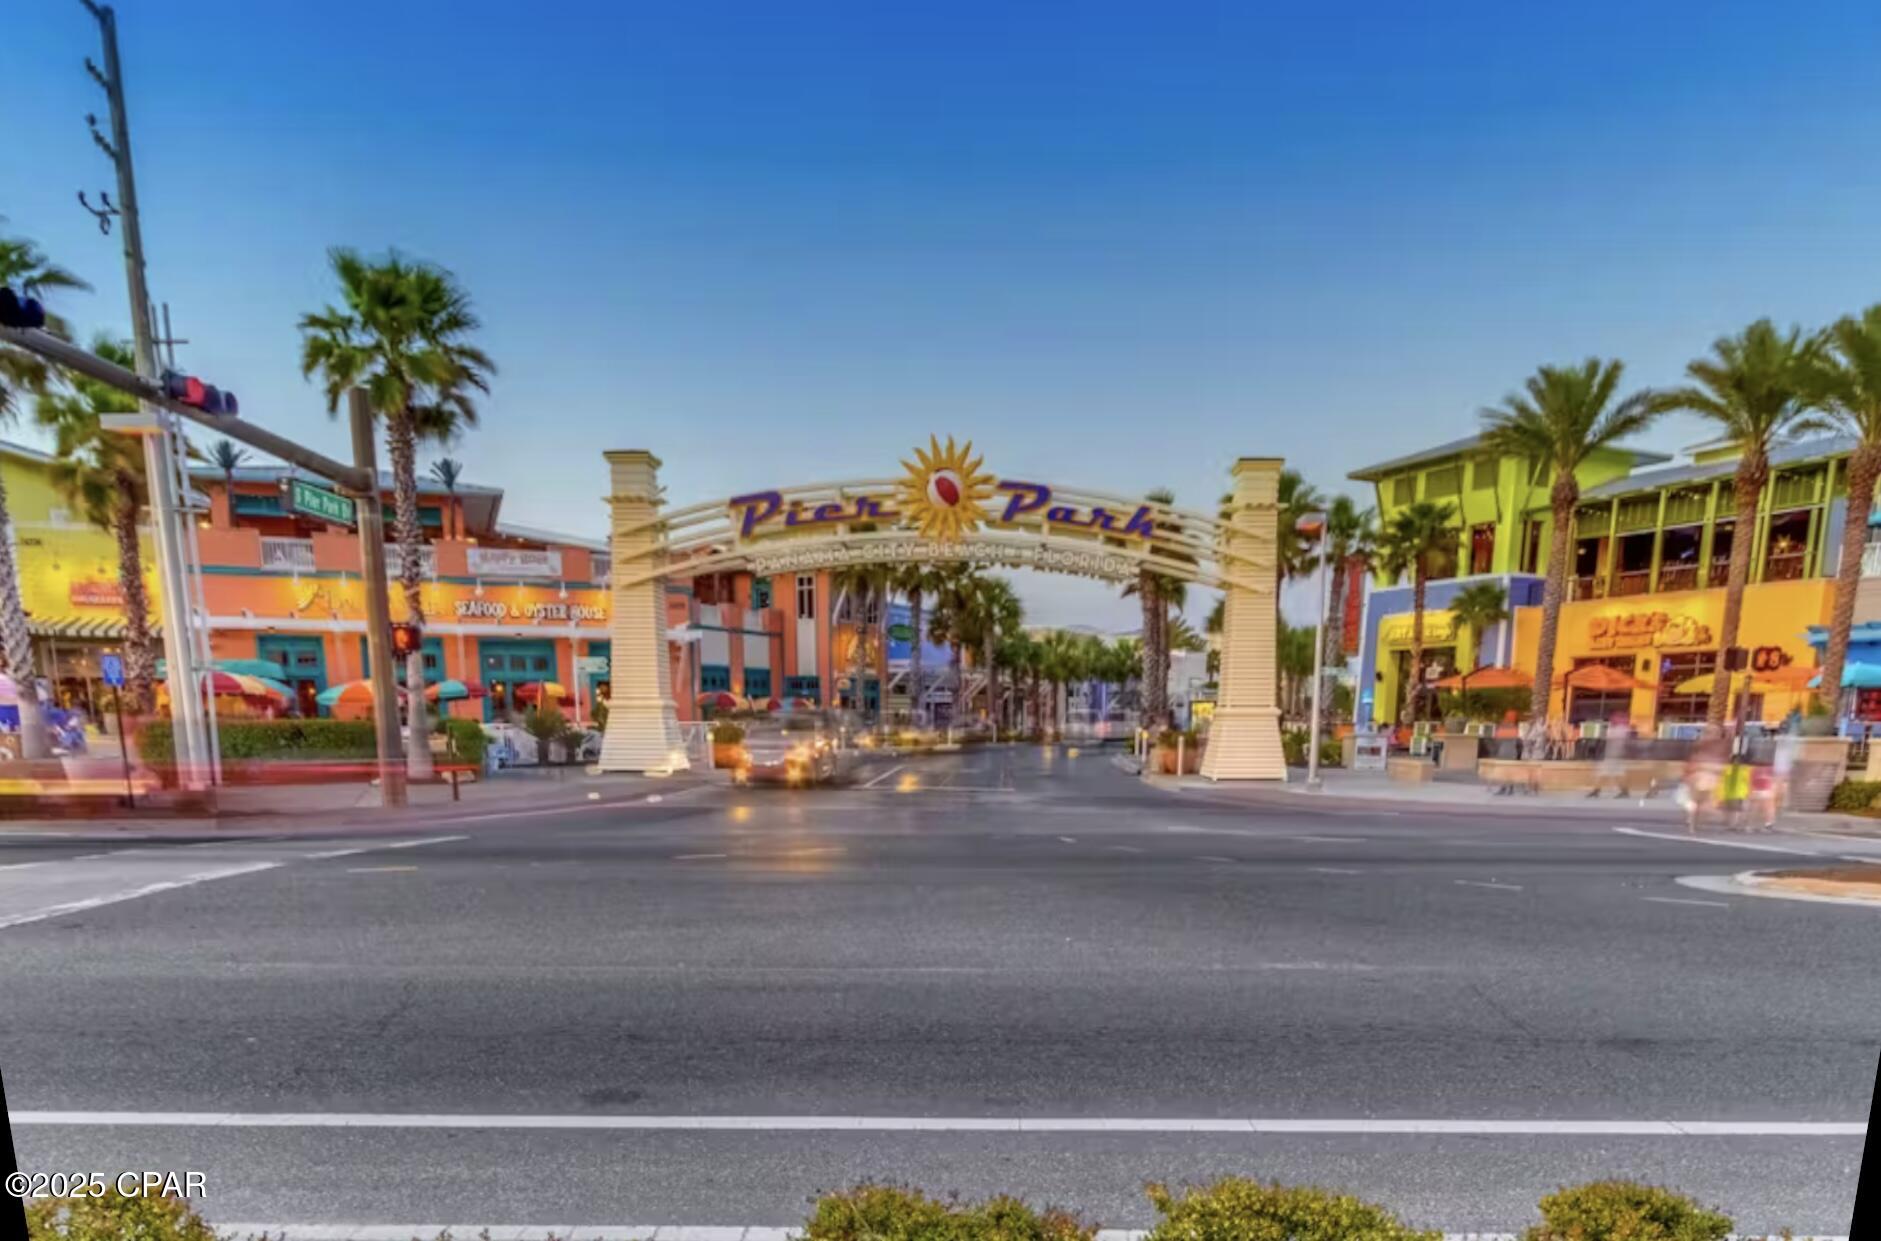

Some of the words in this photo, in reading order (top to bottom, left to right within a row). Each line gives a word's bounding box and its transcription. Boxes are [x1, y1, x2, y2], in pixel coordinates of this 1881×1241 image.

[729, 488, 901, 539] Pier
[1001, 480, 1154, 539] Park
[755, 548, 850, 572] PANAMA
[862, 543, 914, 559] CITY
[928, 542, 1004, 558] BEACH
[1033, 547, 1131, 576] FLORIDA
[454, 600, 506, 618] SEAFOOD
[510, 604, 520, 618] &
[524, 603, 567, 619] OYSTER
[570, 604, 606, 620] HOUSE
